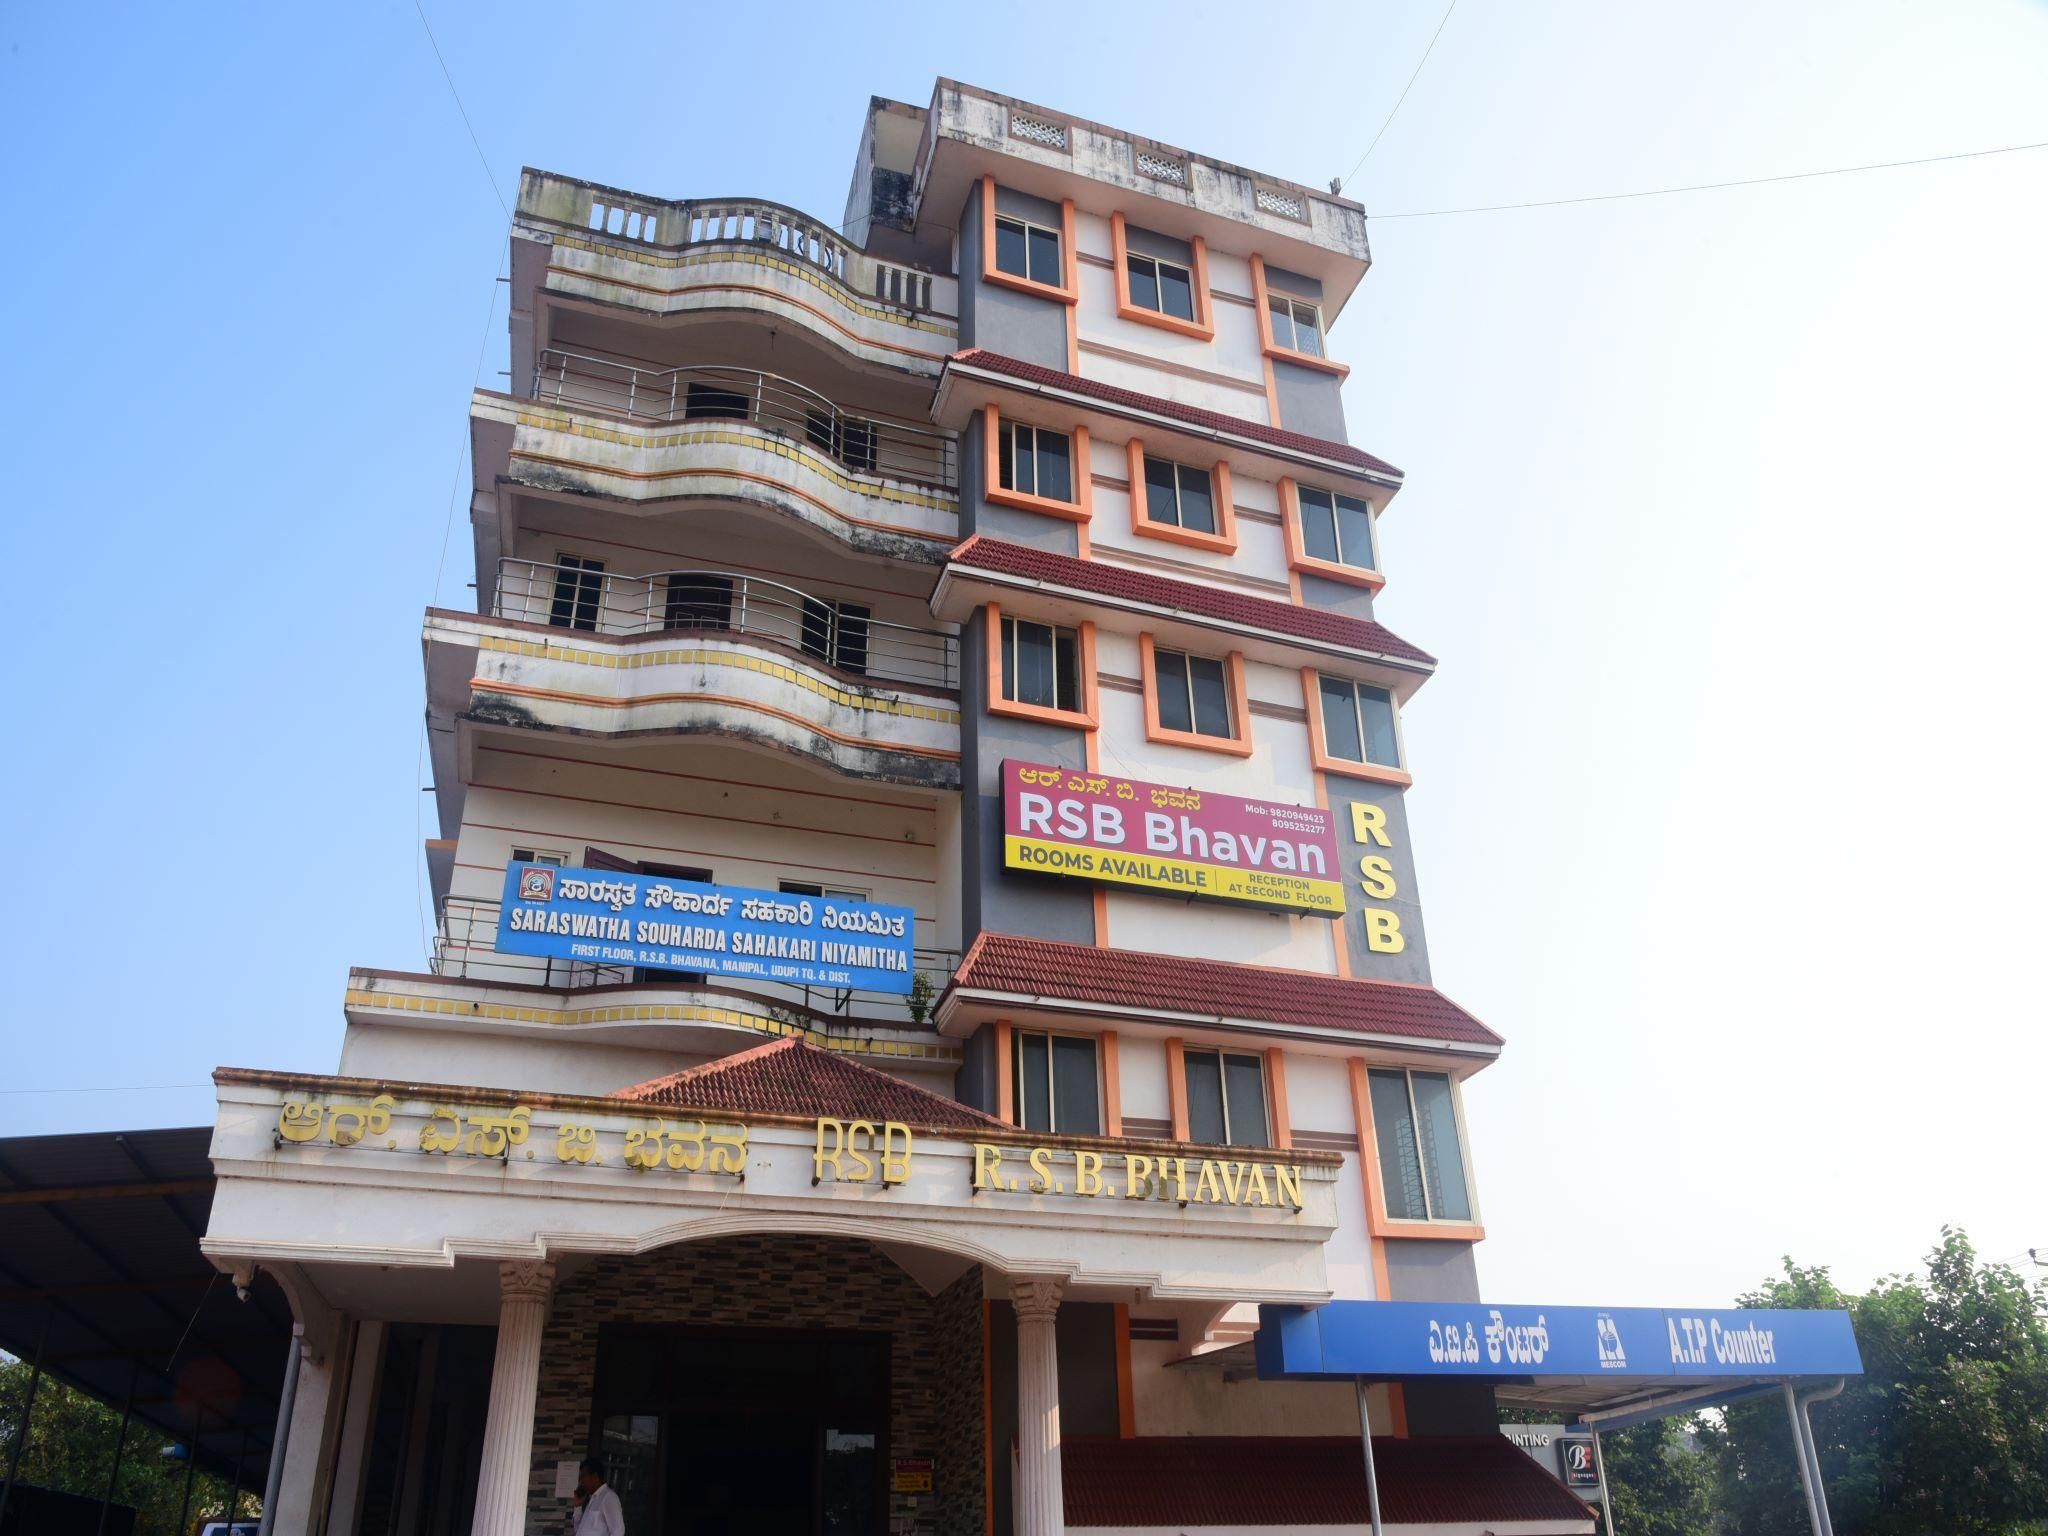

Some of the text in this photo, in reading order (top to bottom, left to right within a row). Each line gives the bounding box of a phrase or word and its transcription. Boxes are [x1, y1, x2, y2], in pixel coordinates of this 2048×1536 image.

[1151, 788, 1201, 811] ಭವನ
[1245, 804, 1325, 824] Mob: 9820949423
[1019, 792, 1327, 875] RSB Bhavan
[1272, 819, 1326, 835] 8095252277
[1019, 845, 1207, 888] ROOMS AVAILABLE
[1249, 874, 1310, 891] RECEPTION
[558, 879, 637, 912] ಸಾರಸ್ವತ
[645, 884, 734, 917] ಸೌಹಾರ್ದ
[741, 898, 814, 926] ಸಹಕಾರಿ
[821, 905, 905, 937] ನಿಯಮಿತ
[1229, 883, 1332, 905] AT SECOND FLOOR
[510, 908, 908, 972] SARASWATHA SOUHARDA SAHAKARI NIYAMITHA
[571, 944, 851, 984] FIRST FLOOR, R.S.B. BHAVANA, MANIPAL, UDUPI TQ. & DIST.
[813, 1117, 912, 1183] RSB
[1124, 1154, 1303, 1208] BHAVAN
[1484, 1310, 1549, 1364] ಕೌಂಟರ್
[1710, 1318, 1777, 1364] Counter
[1600, 1360, 1627, 1369] MESCOM
